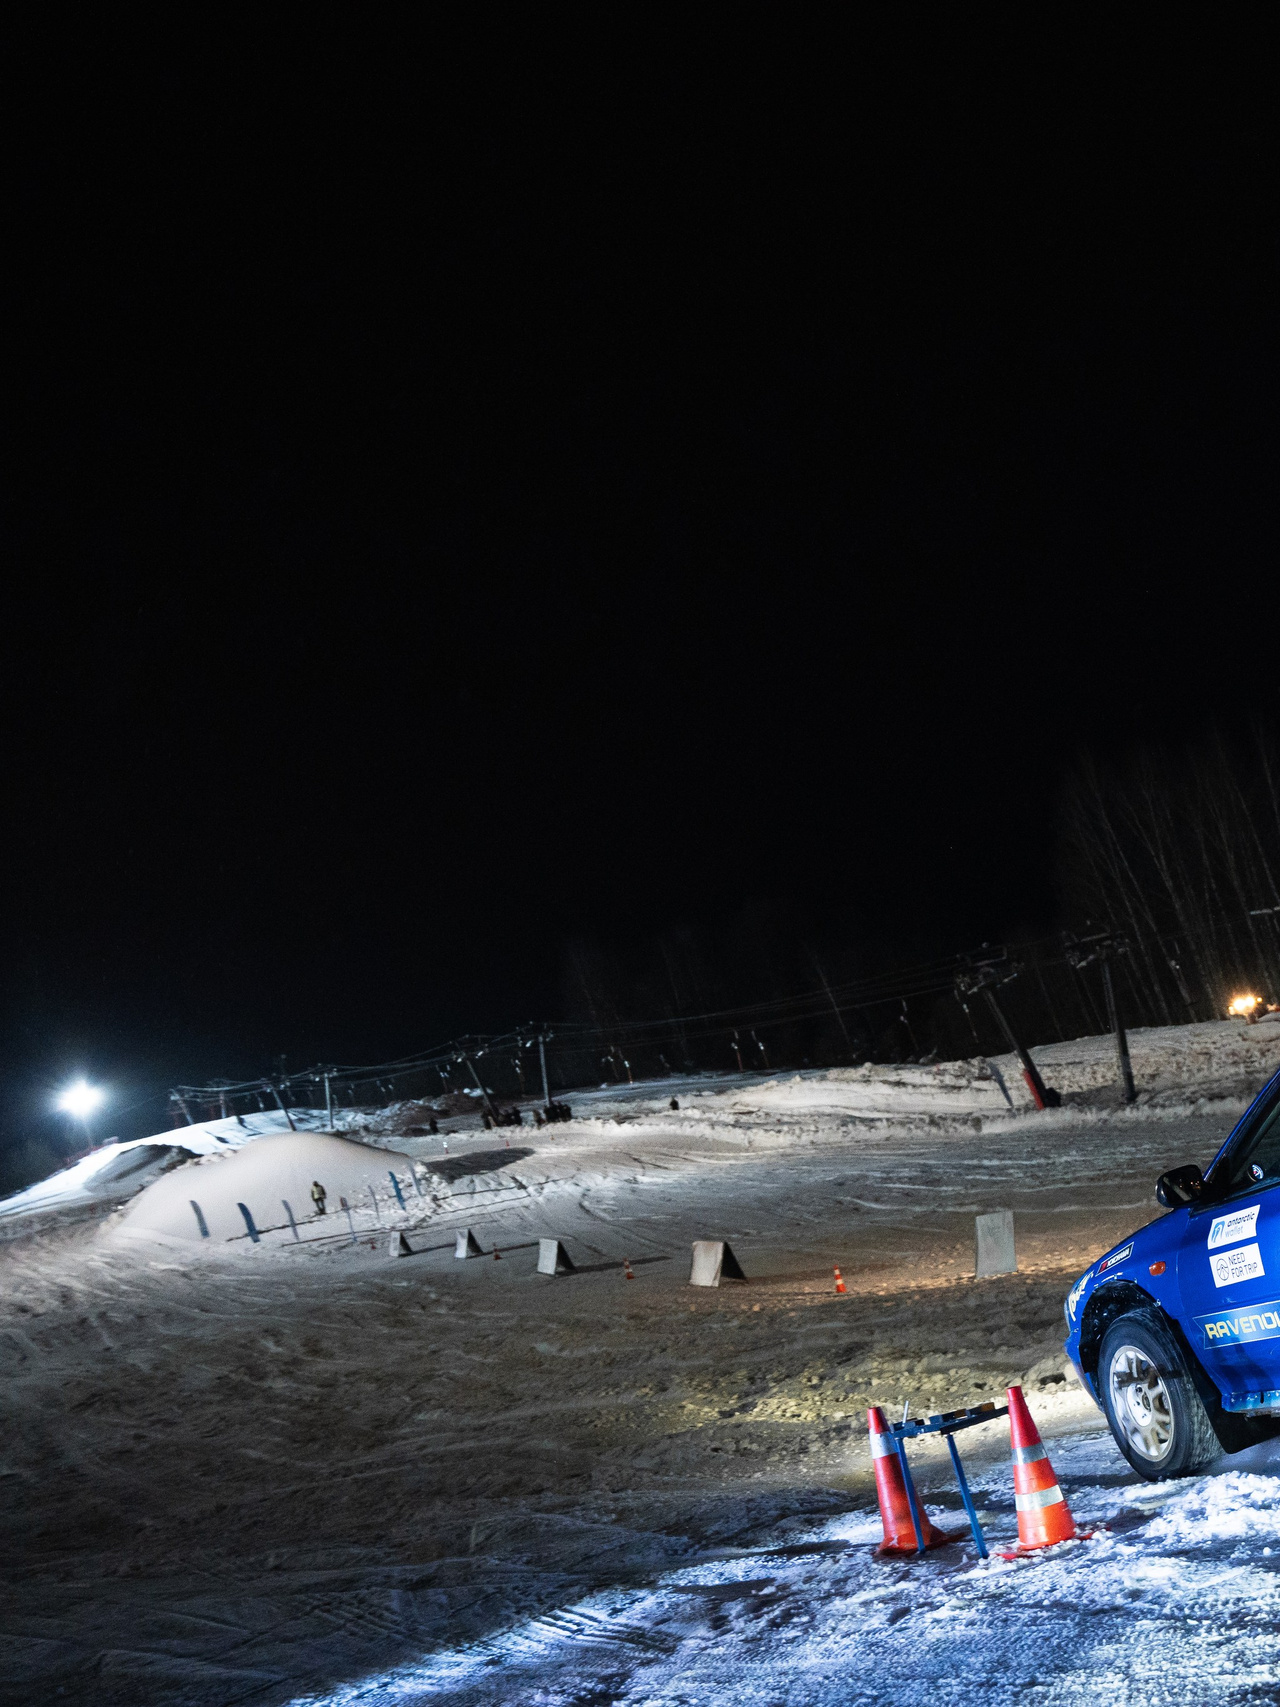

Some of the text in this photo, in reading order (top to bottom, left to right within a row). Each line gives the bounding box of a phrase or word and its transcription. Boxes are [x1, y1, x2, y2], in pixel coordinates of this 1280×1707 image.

[1227, 1212, 1255, 1227] antarctic
[1228, 1252, 1246, 1265] NEED
[1231, 1262, 1258, 1279] FOR TRIP
